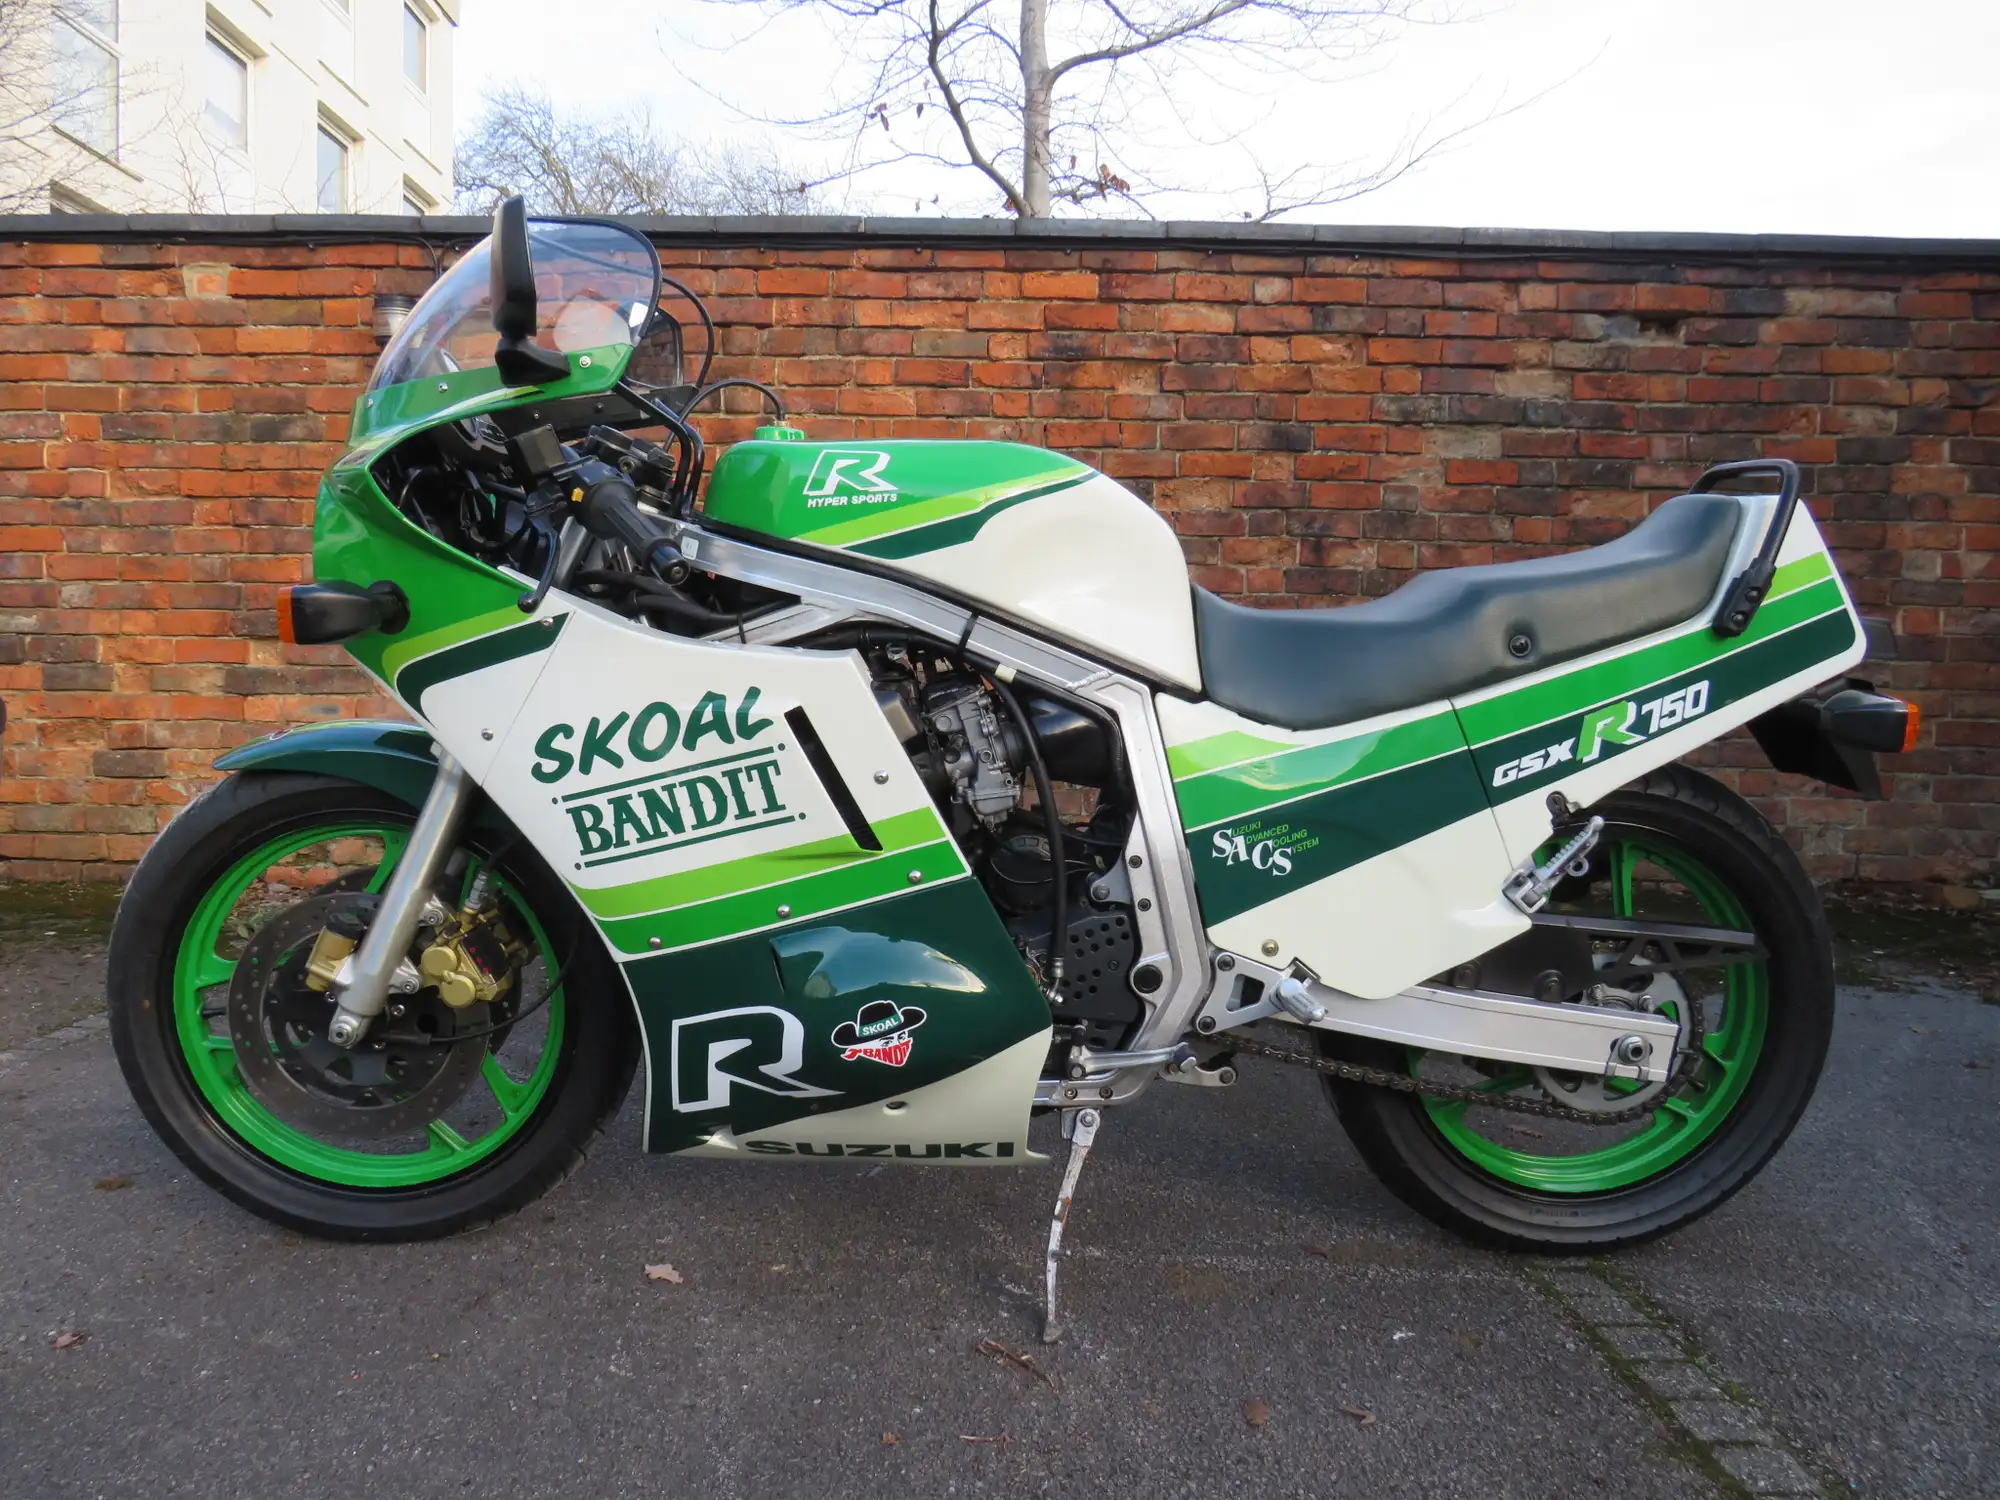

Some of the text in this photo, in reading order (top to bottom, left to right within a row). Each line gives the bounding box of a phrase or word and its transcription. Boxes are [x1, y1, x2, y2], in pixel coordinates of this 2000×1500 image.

[807, 493, 898, 508] HYPER SPORTS
[1641, 680, 1710, 734] 750
[531, 686, 774, 784] SKOAL
[565, 759, 787, 856] BANDIT
[862, 1017, 898, 1036] SKOAL
[745, 1140, 1015, 1159] SUZUKI
